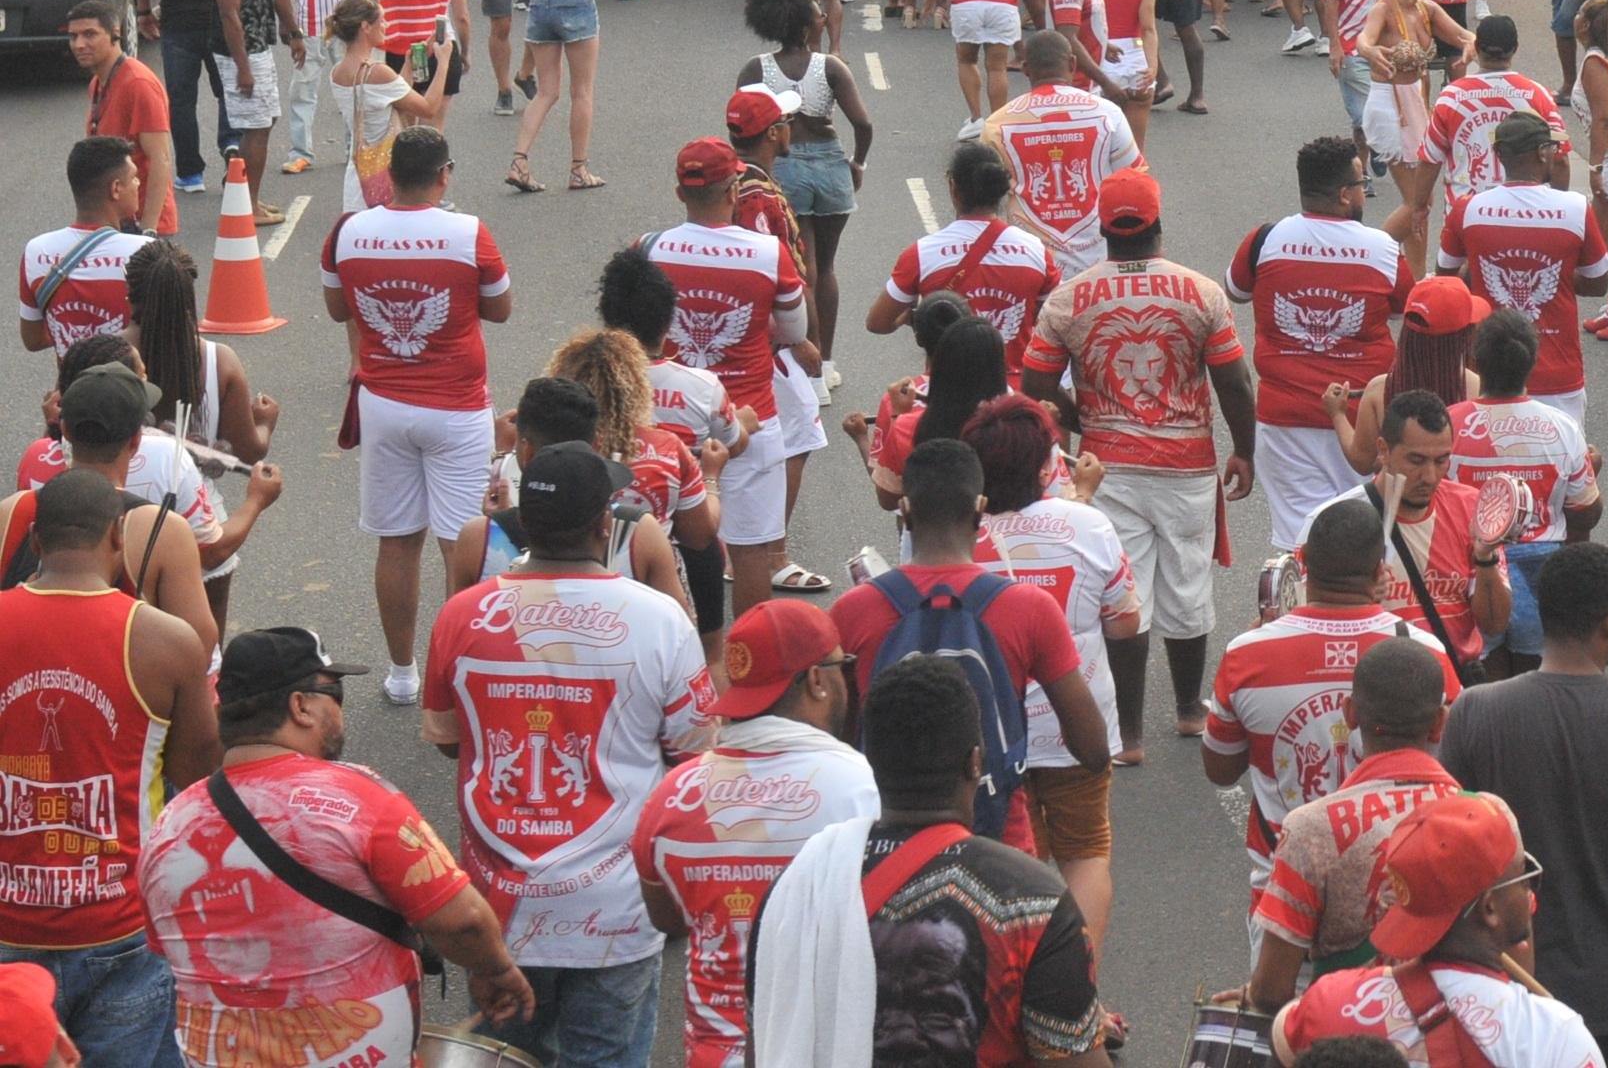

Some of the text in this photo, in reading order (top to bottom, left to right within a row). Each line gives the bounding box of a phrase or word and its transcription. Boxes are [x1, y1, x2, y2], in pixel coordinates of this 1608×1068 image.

[1007, 92, 1091, 113] Diretoria
[1455, 86, 1534, 102] Harmonia Geral
[1457, 111, 1511, 146] IMPERAD
[1024, 132, 1085, 147] IMPERADORES
[1053, 210, 1083, 220] SAMBA
[941, 241, 998, 256] CUÍS
[37, 253, 88, 268] CUÍS
[1071, 274, 1205, 318] BATERIA
[1459, 410, 1552, 440] Bateria
[1015, 575, 1057, 587] ADORES
[470, 585, 628, 634] Bateria
[33, 670, 40, 689] A
[40, 666, 85, 700] RESISTÊNCIA
[84, 687, 97, 704] DO
[96, 690, 119, 741] SAMBA
[487, 683, 593, 703] IMPERADORES
[666, 763, 820, 812] Bateria
[38, 795, 67, 822] DE
[291, 793, 354, 814] Imperador
[497, 818, 574, 835] DO SAMBA
[497, 877, 579, 899] VERMELHO
[582, 874, 594, 889] E
[1341, 975, 1500, 1038] Baria
